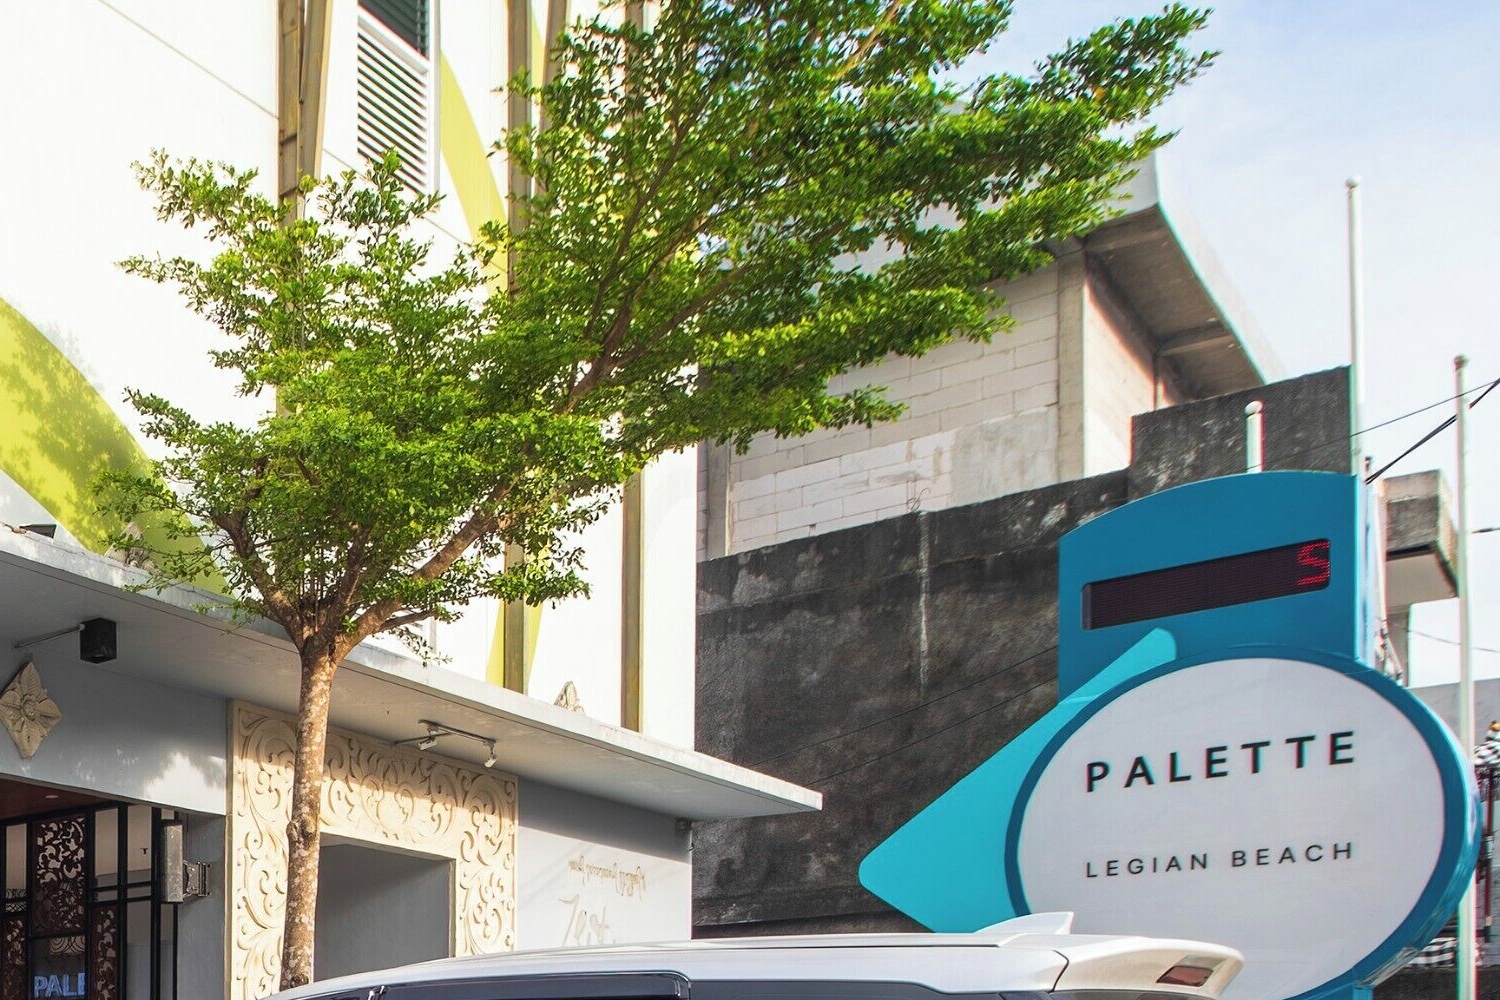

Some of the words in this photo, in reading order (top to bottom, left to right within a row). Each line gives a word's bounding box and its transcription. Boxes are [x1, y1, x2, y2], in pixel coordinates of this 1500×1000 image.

[1086, 730, 1354, 793] PALETTE
[1086, 853, 1207, 878] LEGIAN
[1231, 842, 1352, 868] BEACH
